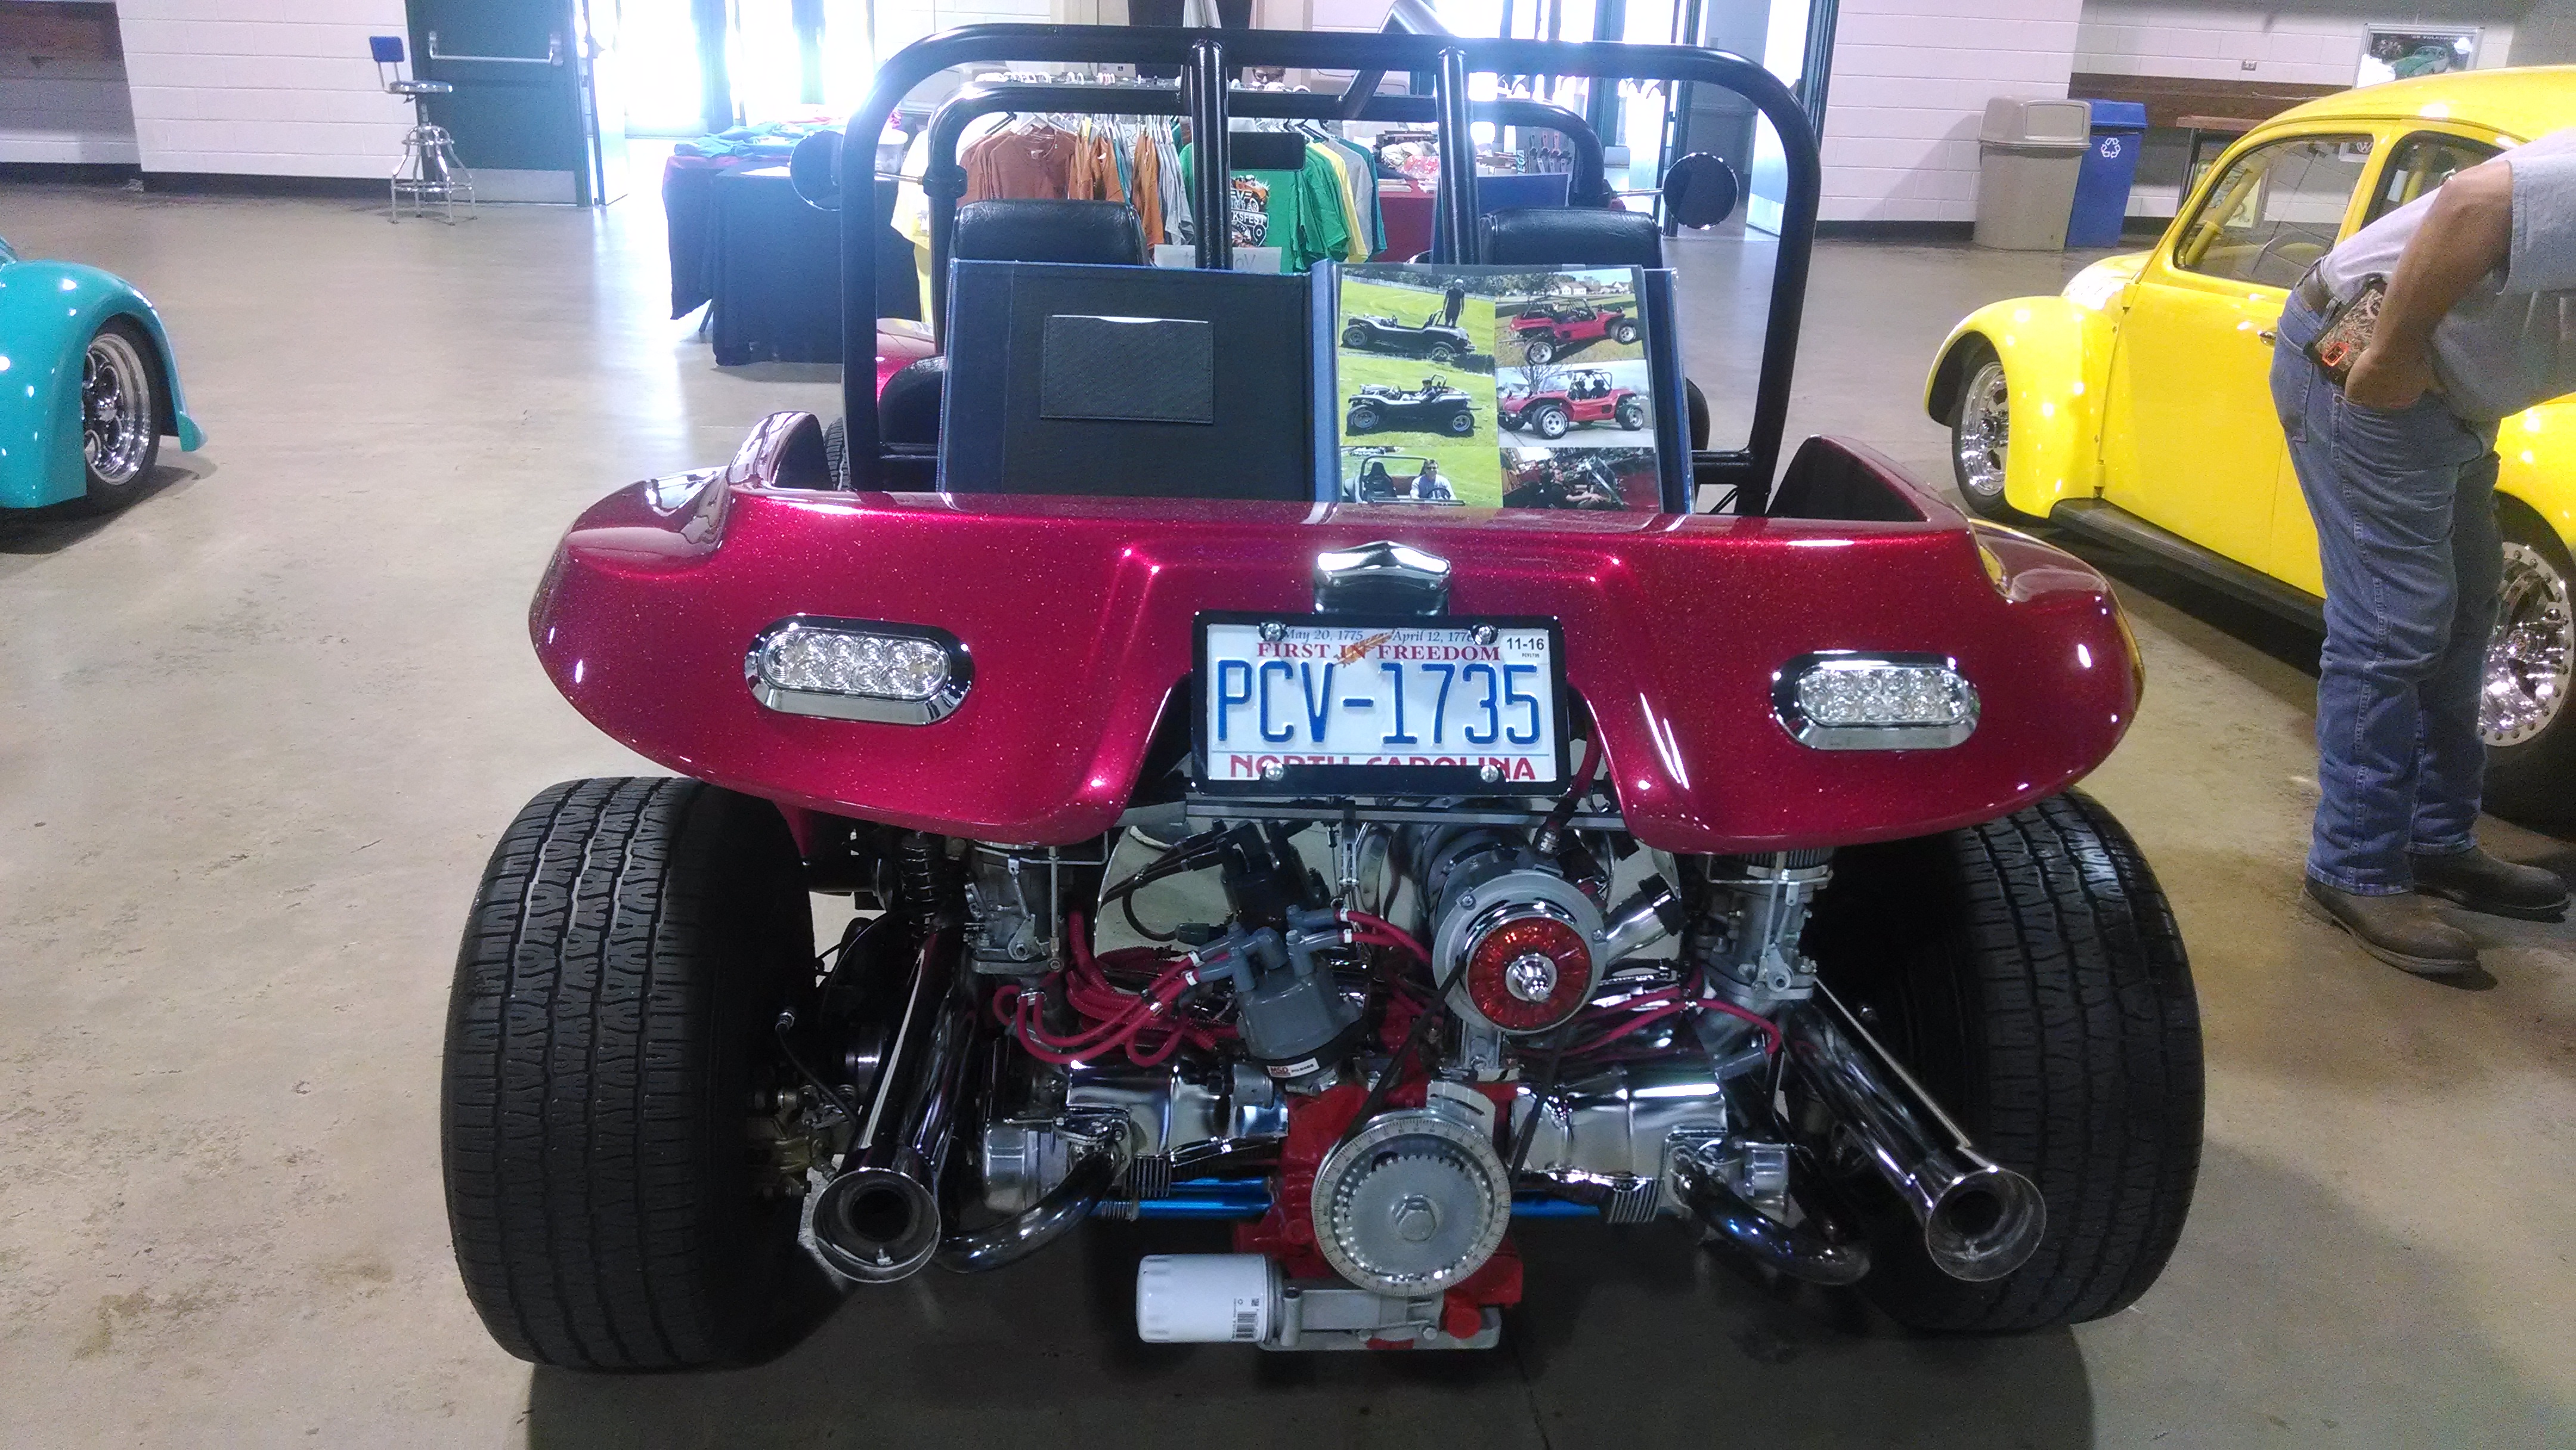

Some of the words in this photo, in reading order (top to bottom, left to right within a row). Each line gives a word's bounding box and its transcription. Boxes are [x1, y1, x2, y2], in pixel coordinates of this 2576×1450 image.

[1516, 150, 1525, 174] EGA
[1233, 212, 1265, 224] KSFEST
[1285, 630, 1310, 643] May
[1314, 630, 1333, 641] 20,
[1337, 630, 1363, 640] 1775
[1393, 631, 1424, 644] April
[1428, 631, 1444, 643] 12,
[1507, 637, 1544, 650] 11-16
[1257, 643, 1330, 658] FIRST
[1339, 645, 1366, 658] IN
[1377, 645, 1501, 661] FREEDOM
[1218, 659, 1540, 744] PCV-1735
